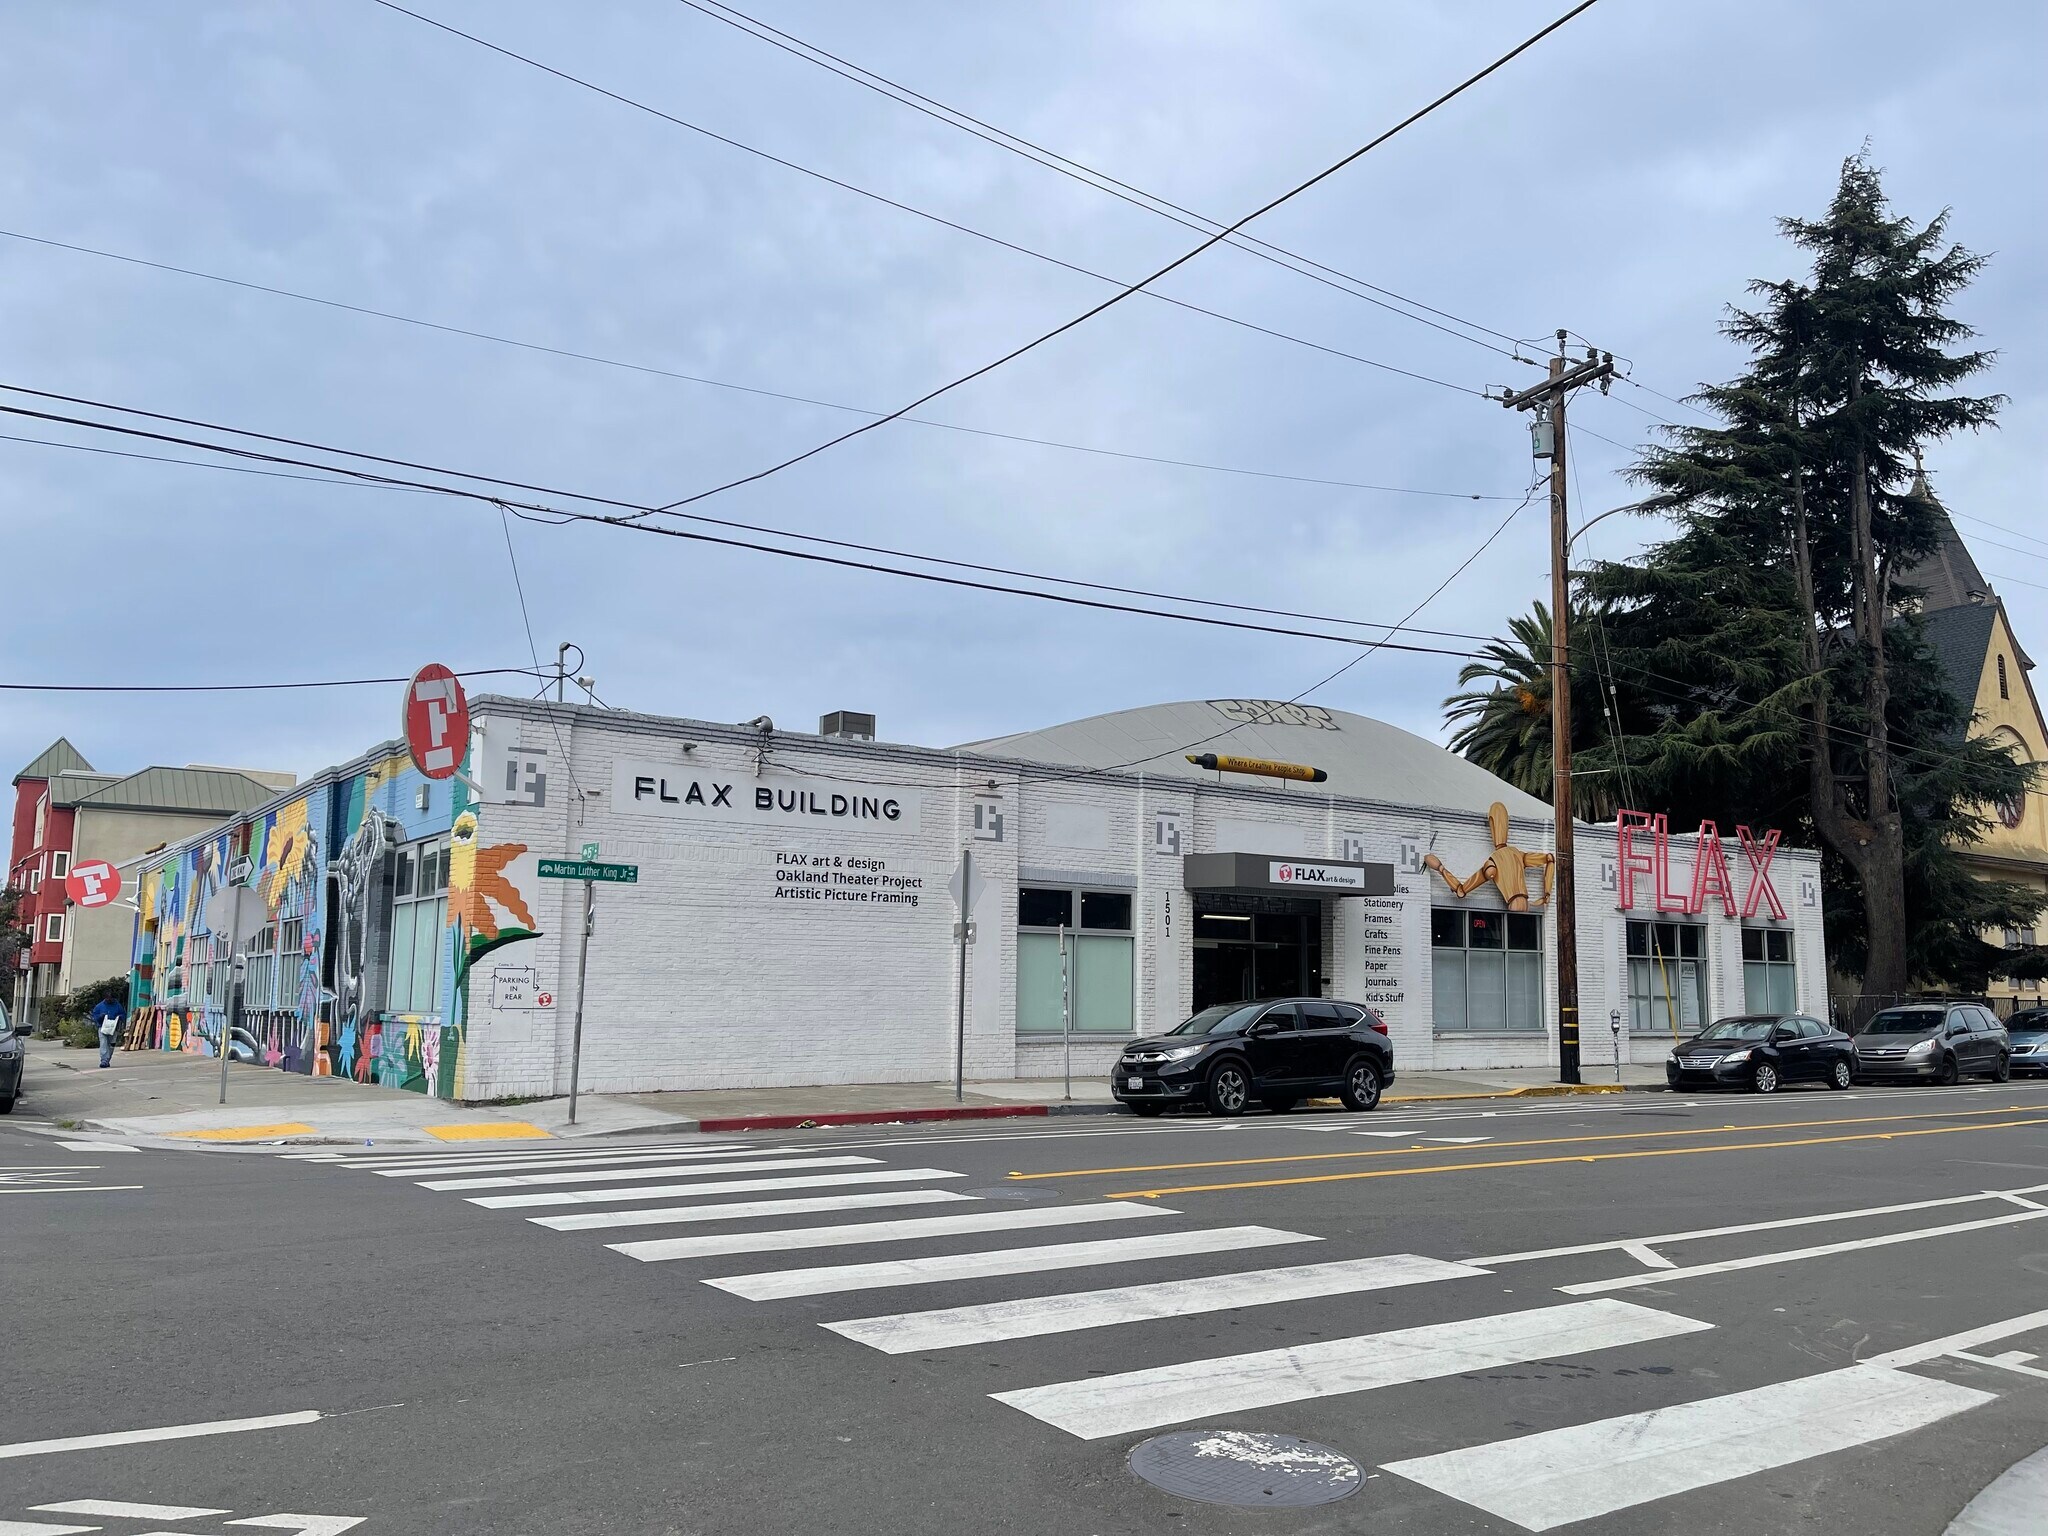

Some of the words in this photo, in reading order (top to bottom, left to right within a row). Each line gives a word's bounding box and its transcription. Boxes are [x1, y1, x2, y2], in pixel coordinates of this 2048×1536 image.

[1227, 758, 1248, 767] Where
[1249, 761, 1272, 771] Creative
[1274, 763, 1292, 774] People
[1292, 766, 1306, 776] Shop
[635, 776, 734, 808] FLAX
[755, 787, 901, 821] BUILDING
[775, 853, 808, 866] FLAX
[812, 856, 831, 867] art
[833, 856, 843, 868] &
[847, 857, 886, 873] design
[1618, 808, 1788, 920] FLAX
[554, 864, 576, 875] Martin
[578, 866, 601, 877] Luther
[603, 867, 618, 880] King
[620, 869, 627, 879] Jr
[1295, 868, 1326, 882] FLAX
[1339, 877, 1356, 885] design
[776, 869, 829, 883] Oakland
[832, 872, 879, 886] Theater
[882, 875, 923, 890] Project
[775, 886, 822, 900] Artistic
[824, 889, 868, 902] Picture
[871, 891, 919, 907] Framing
[1364, 898, 1404, 911] Stationery
[1364, 914, 1393, 923] Frames
[1364, 929, 1388, 939] Crafts
[1365, 945, 1381, 954] Fine
[1382, 946, 1401, 955] Pens
[1365, 961, 1388, 972] Paper
[1365, 977, 1398, 988] Journals
[1365, 993, 1384, 1002] Kid's
[1385, 993, 1404, 1002] Stuff
[1368, 1008, 1385, 1018] ifts
